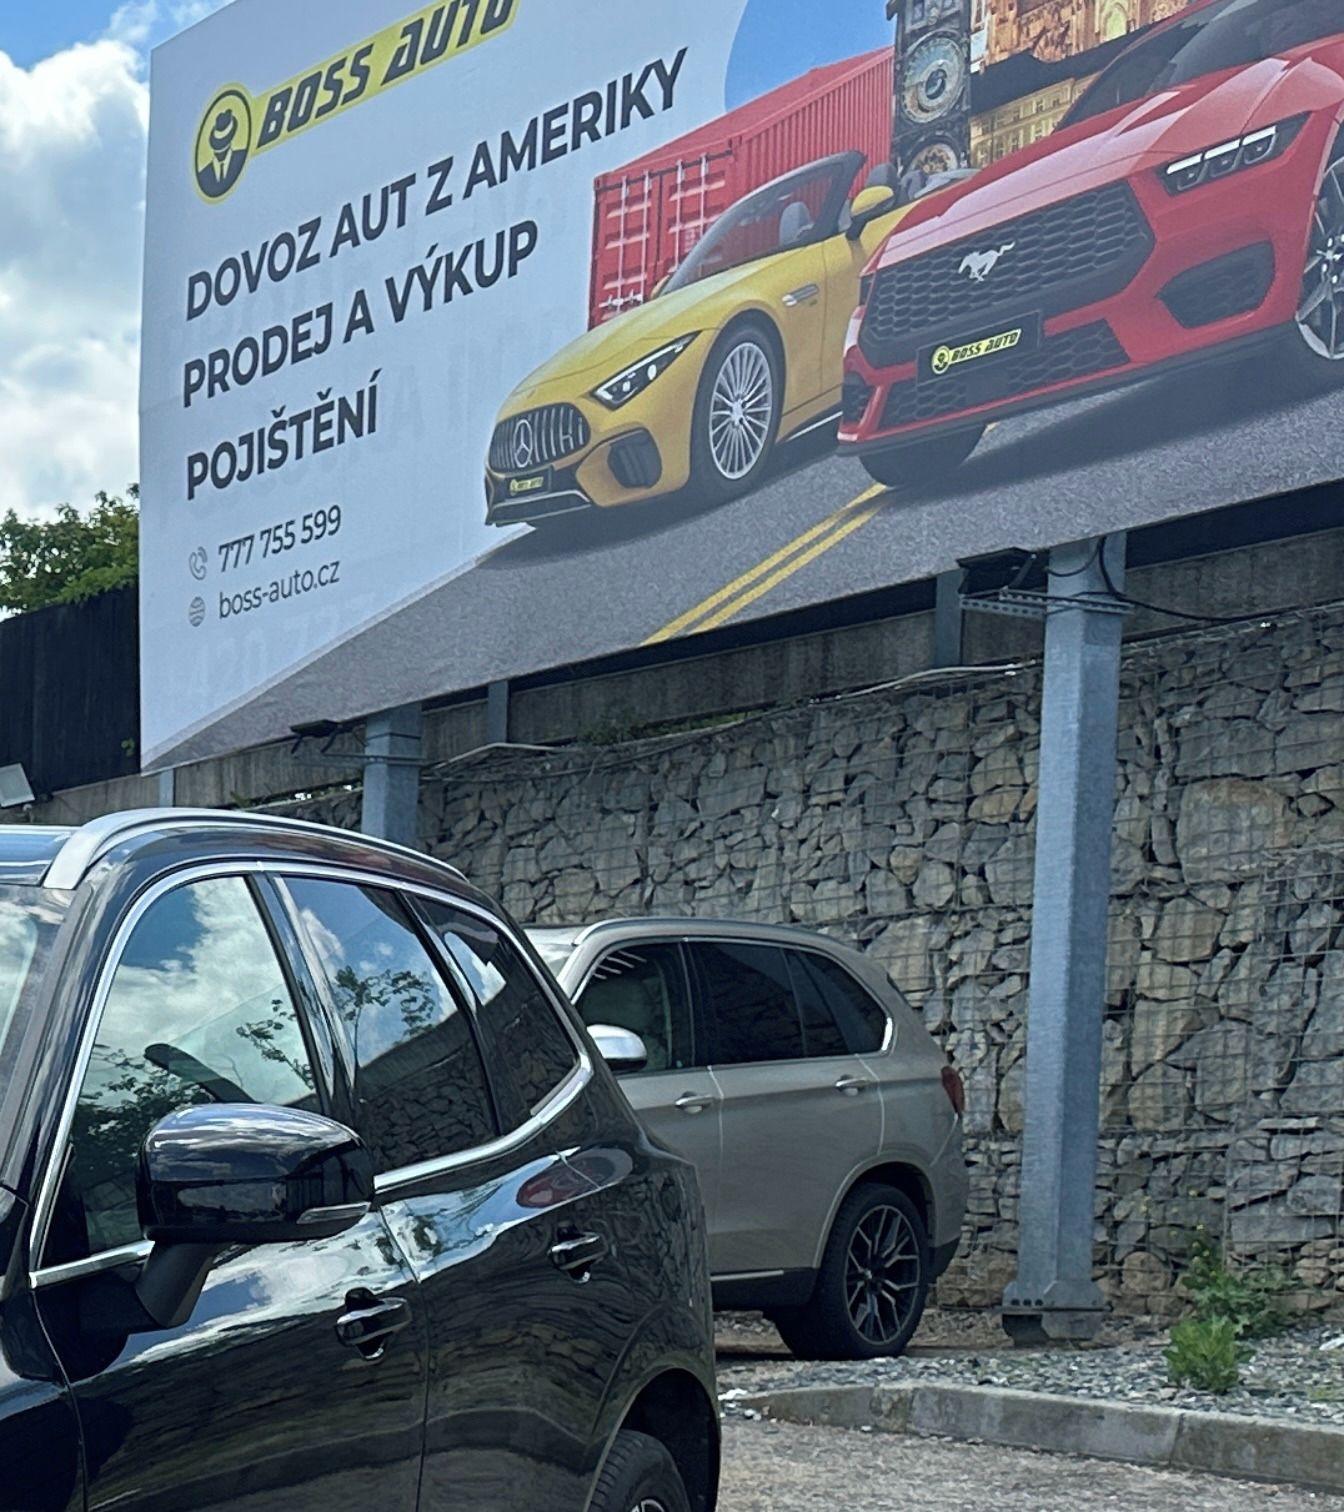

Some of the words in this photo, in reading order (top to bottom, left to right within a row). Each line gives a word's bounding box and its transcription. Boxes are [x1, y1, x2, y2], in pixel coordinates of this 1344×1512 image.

[256, 43, 374, 149] BOSS
[186, 216, 322, 321] DOVOZ
[328, 172, 417, 258] AUT
[425, 156, 454, 216] Z
[462, 46, 688, 200] AMERIKY
[183, 301, 333, 408] PRODEJ
[343, 289, 375, 344] A
[385, 219, 538, 323] VÝKUP
[952, 343, 982, 361] BOSS
[985, 332, 1018, 352] AUTO
[186, 368, 383, 500] POJIŠTĚNÍ
[218, 534, 255, 572] 777
[260, 519, 296, 558] 755
[301, 505, 341, 544] 599
[219, 561, 340, 619] boss-auto.cz
